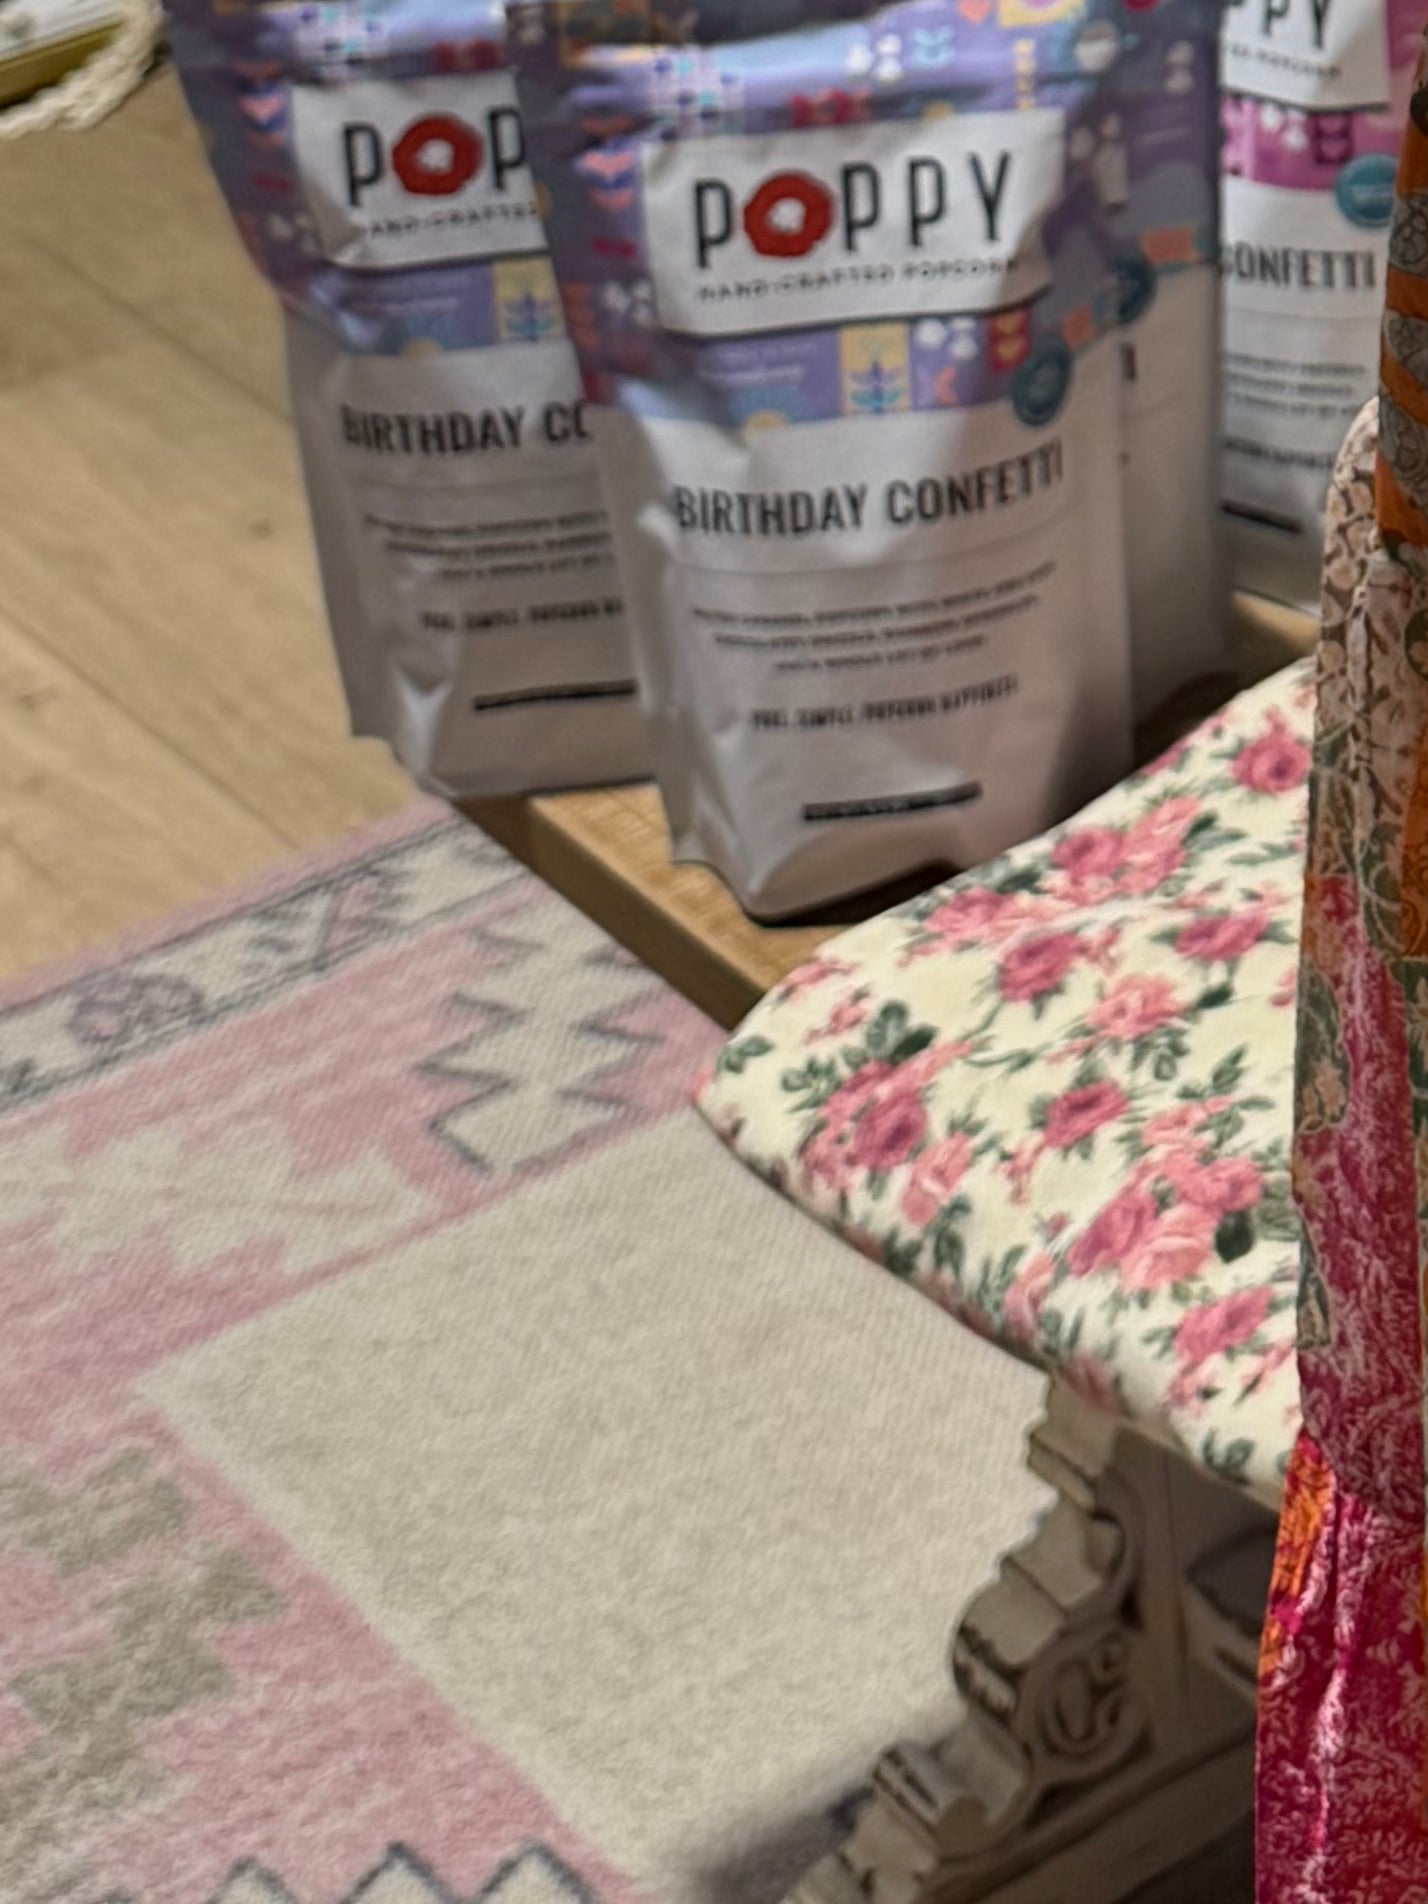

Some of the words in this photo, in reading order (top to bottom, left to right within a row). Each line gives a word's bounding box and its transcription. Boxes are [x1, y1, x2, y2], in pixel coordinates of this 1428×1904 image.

[694, 148, 1011, 268] POPPY
[340, 404, 525, 455] BIRTHDAY
[674, 484, 869, 536] BIRTHDAY
[887, 439, 1064, 525] CONFETTI
